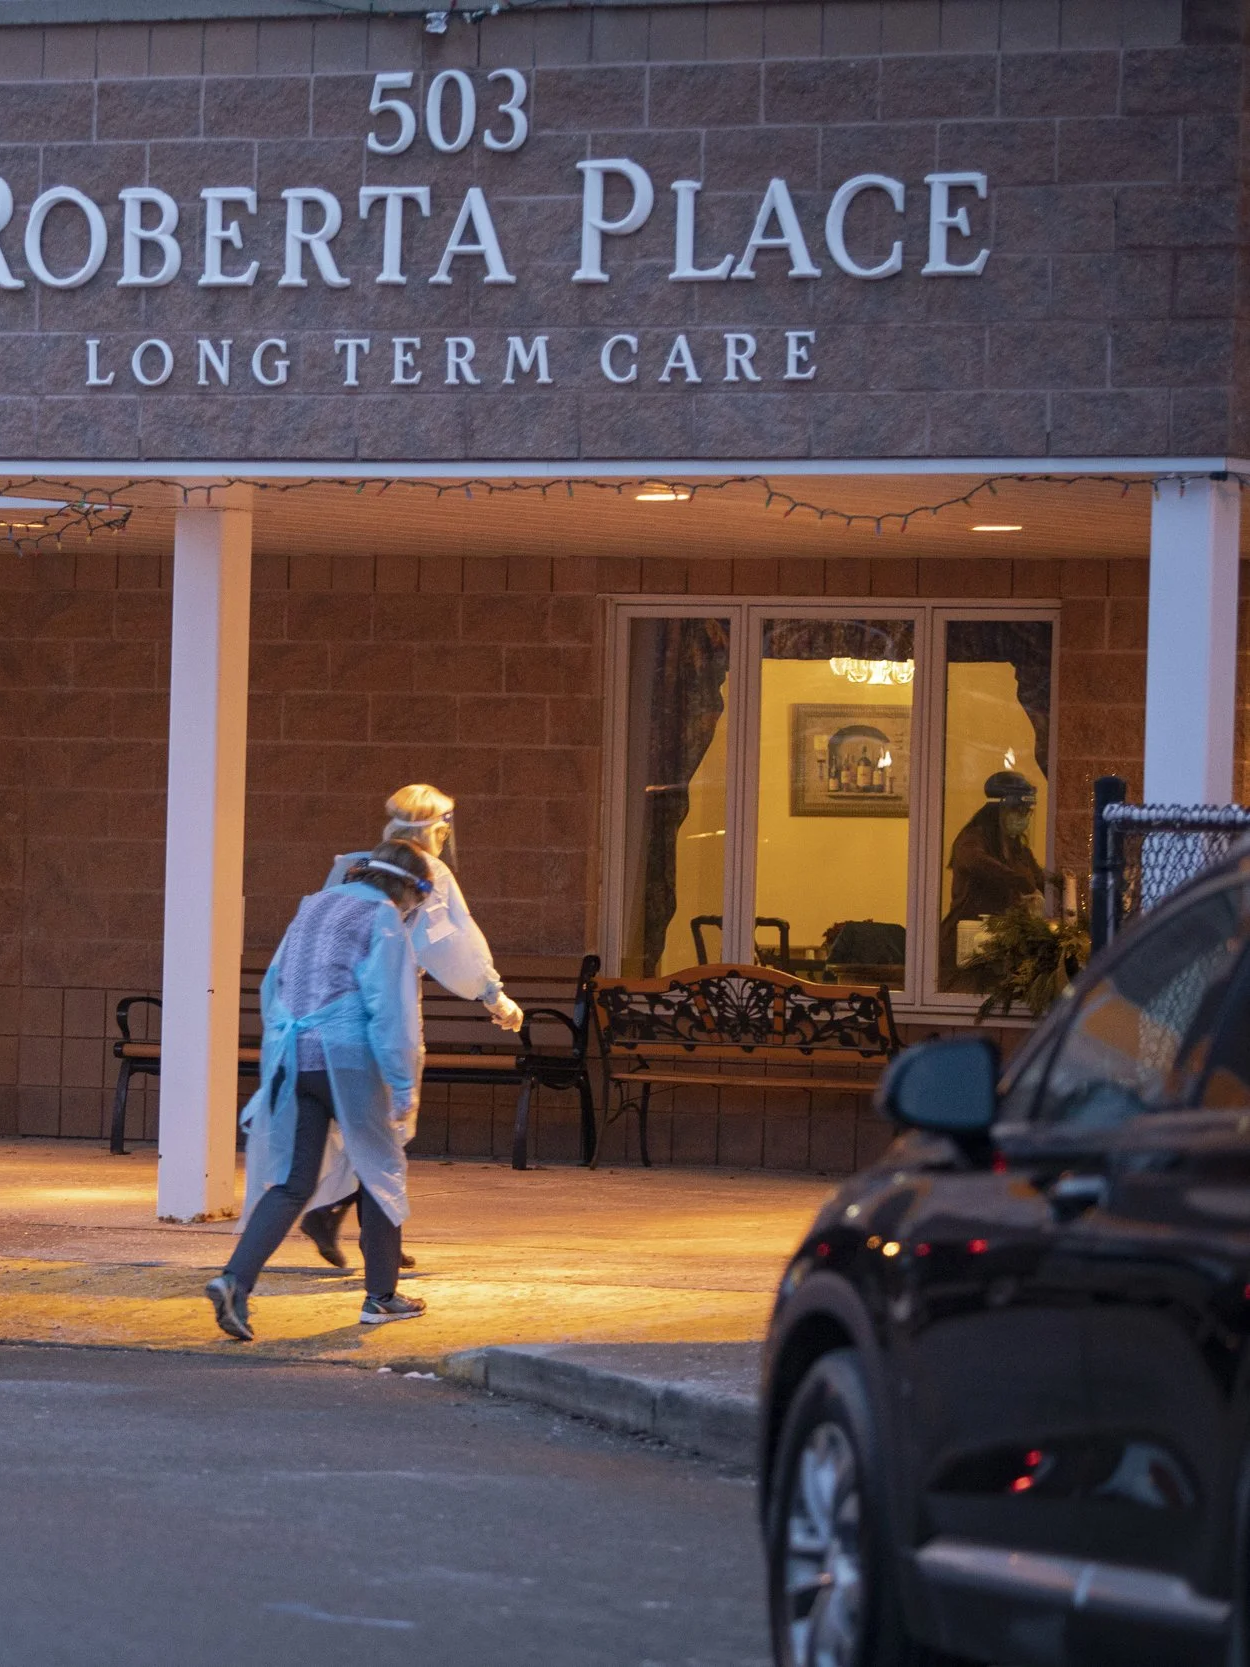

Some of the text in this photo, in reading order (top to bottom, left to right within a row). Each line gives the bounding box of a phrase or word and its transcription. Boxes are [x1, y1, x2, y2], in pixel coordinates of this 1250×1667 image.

[366, 68, 528, 152] 503
[571, 158, 991, 282] PLACE
[84, 330, 818, 387] LONG TERM CARE
